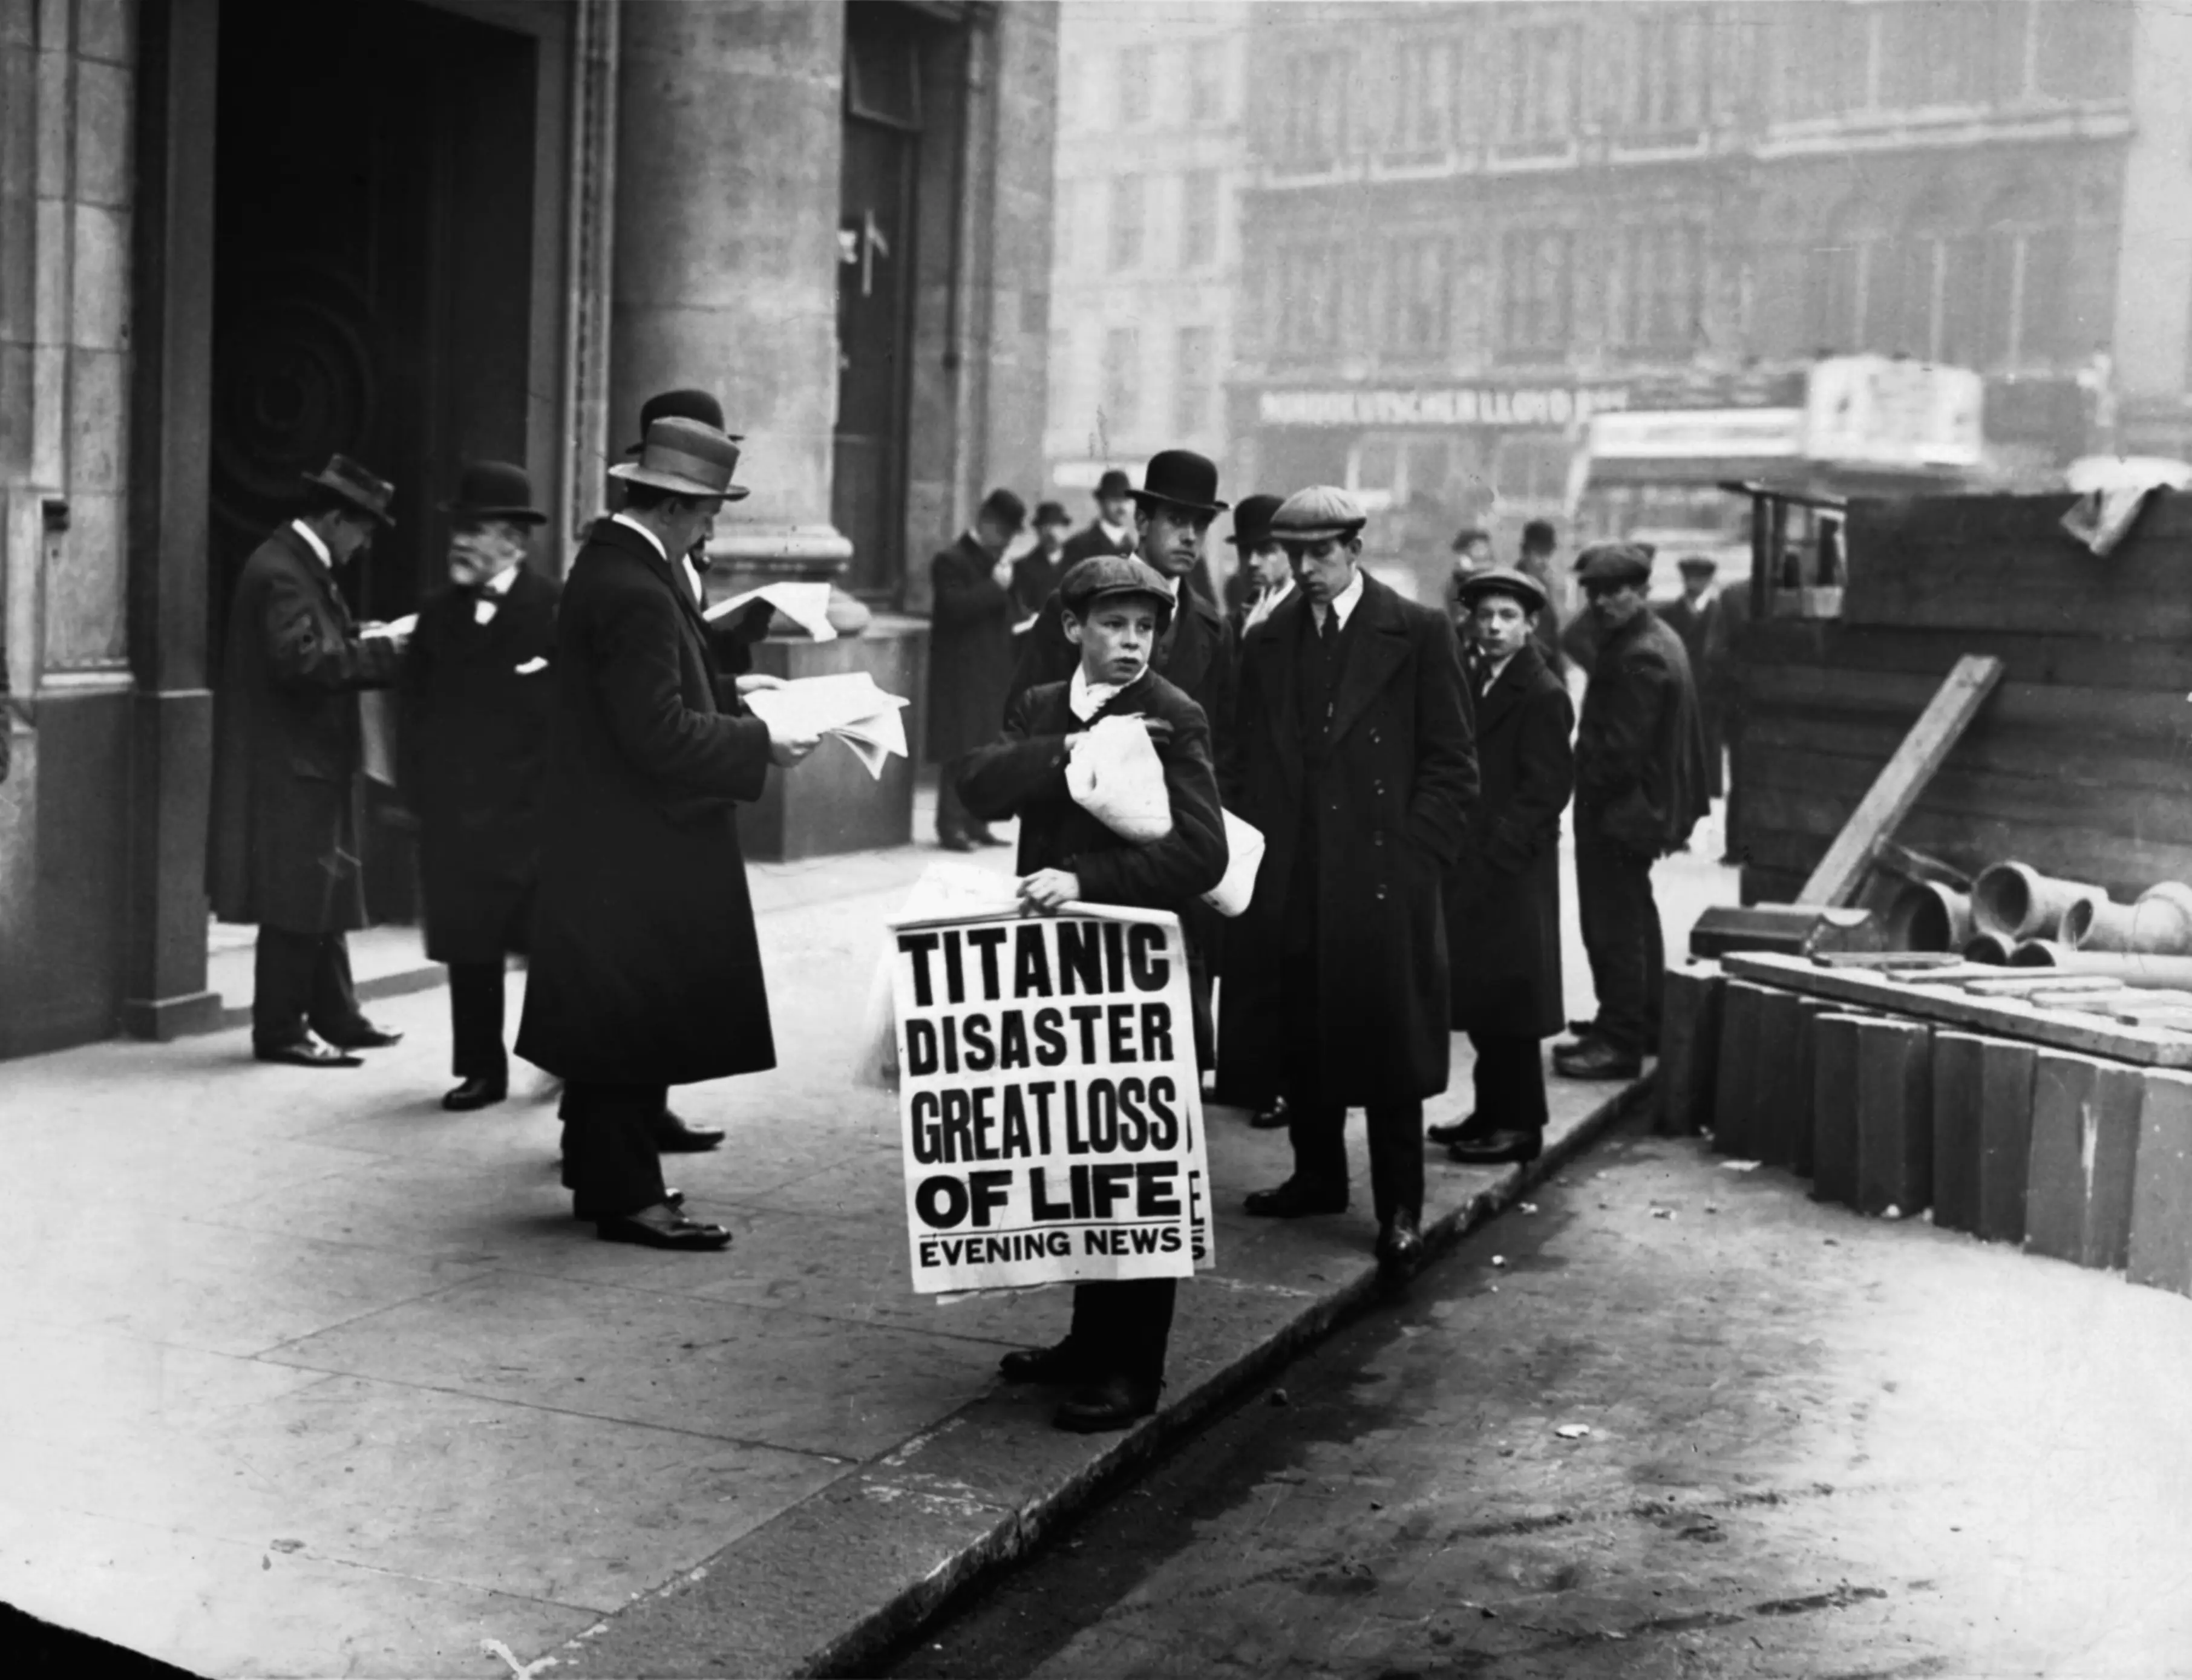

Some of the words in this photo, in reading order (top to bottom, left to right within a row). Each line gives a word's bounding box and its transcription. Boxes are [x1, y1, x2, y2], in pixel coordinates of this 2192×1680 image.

[897, 921, 1170, 1006] TITANIC
[906, 1002, 1174, 1076] DISASTER
[911, 1082, 1055, 1164] GREAT
[1065, 1076, 1178, 1154] LOSS
[915, 1170, 1012, 1229] OF
[1029, 1161, 1181, 1221] LIFE
[920, 1231, 1071, 1267] EVENING
[1084, 1227, 1181, 1255] NEWS
